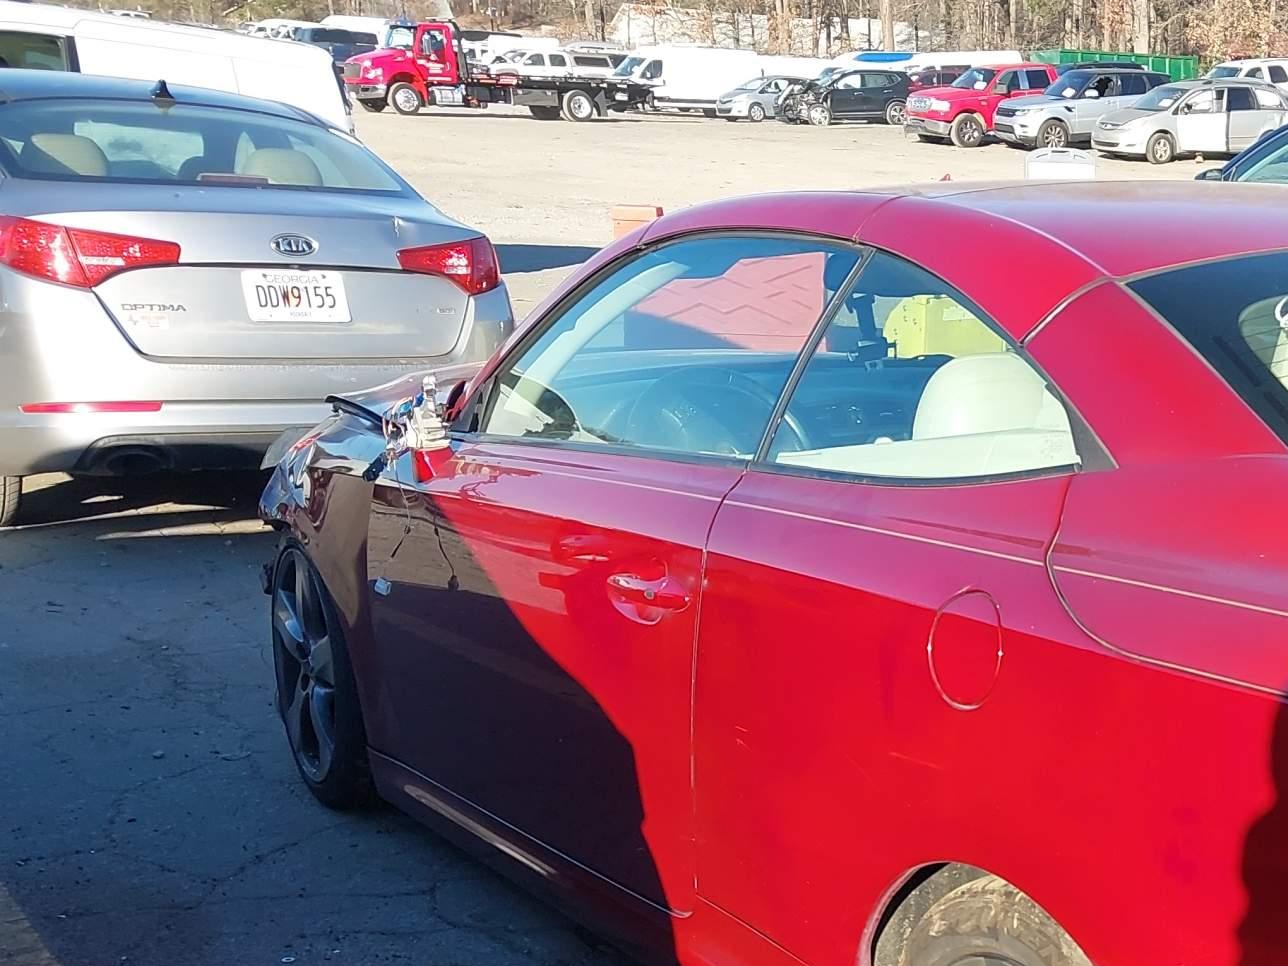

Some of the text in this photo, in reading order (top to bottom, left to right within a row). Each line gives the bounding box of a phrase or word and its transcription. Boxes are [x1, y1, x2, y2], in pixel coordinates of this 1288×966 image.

[278, 238, 313, 252] KIA
[265, 274, 319, 284] GEORGIA
[255, 285, 336, 308] DDW9155
[121, 303, 187, 312] OPTIMA
